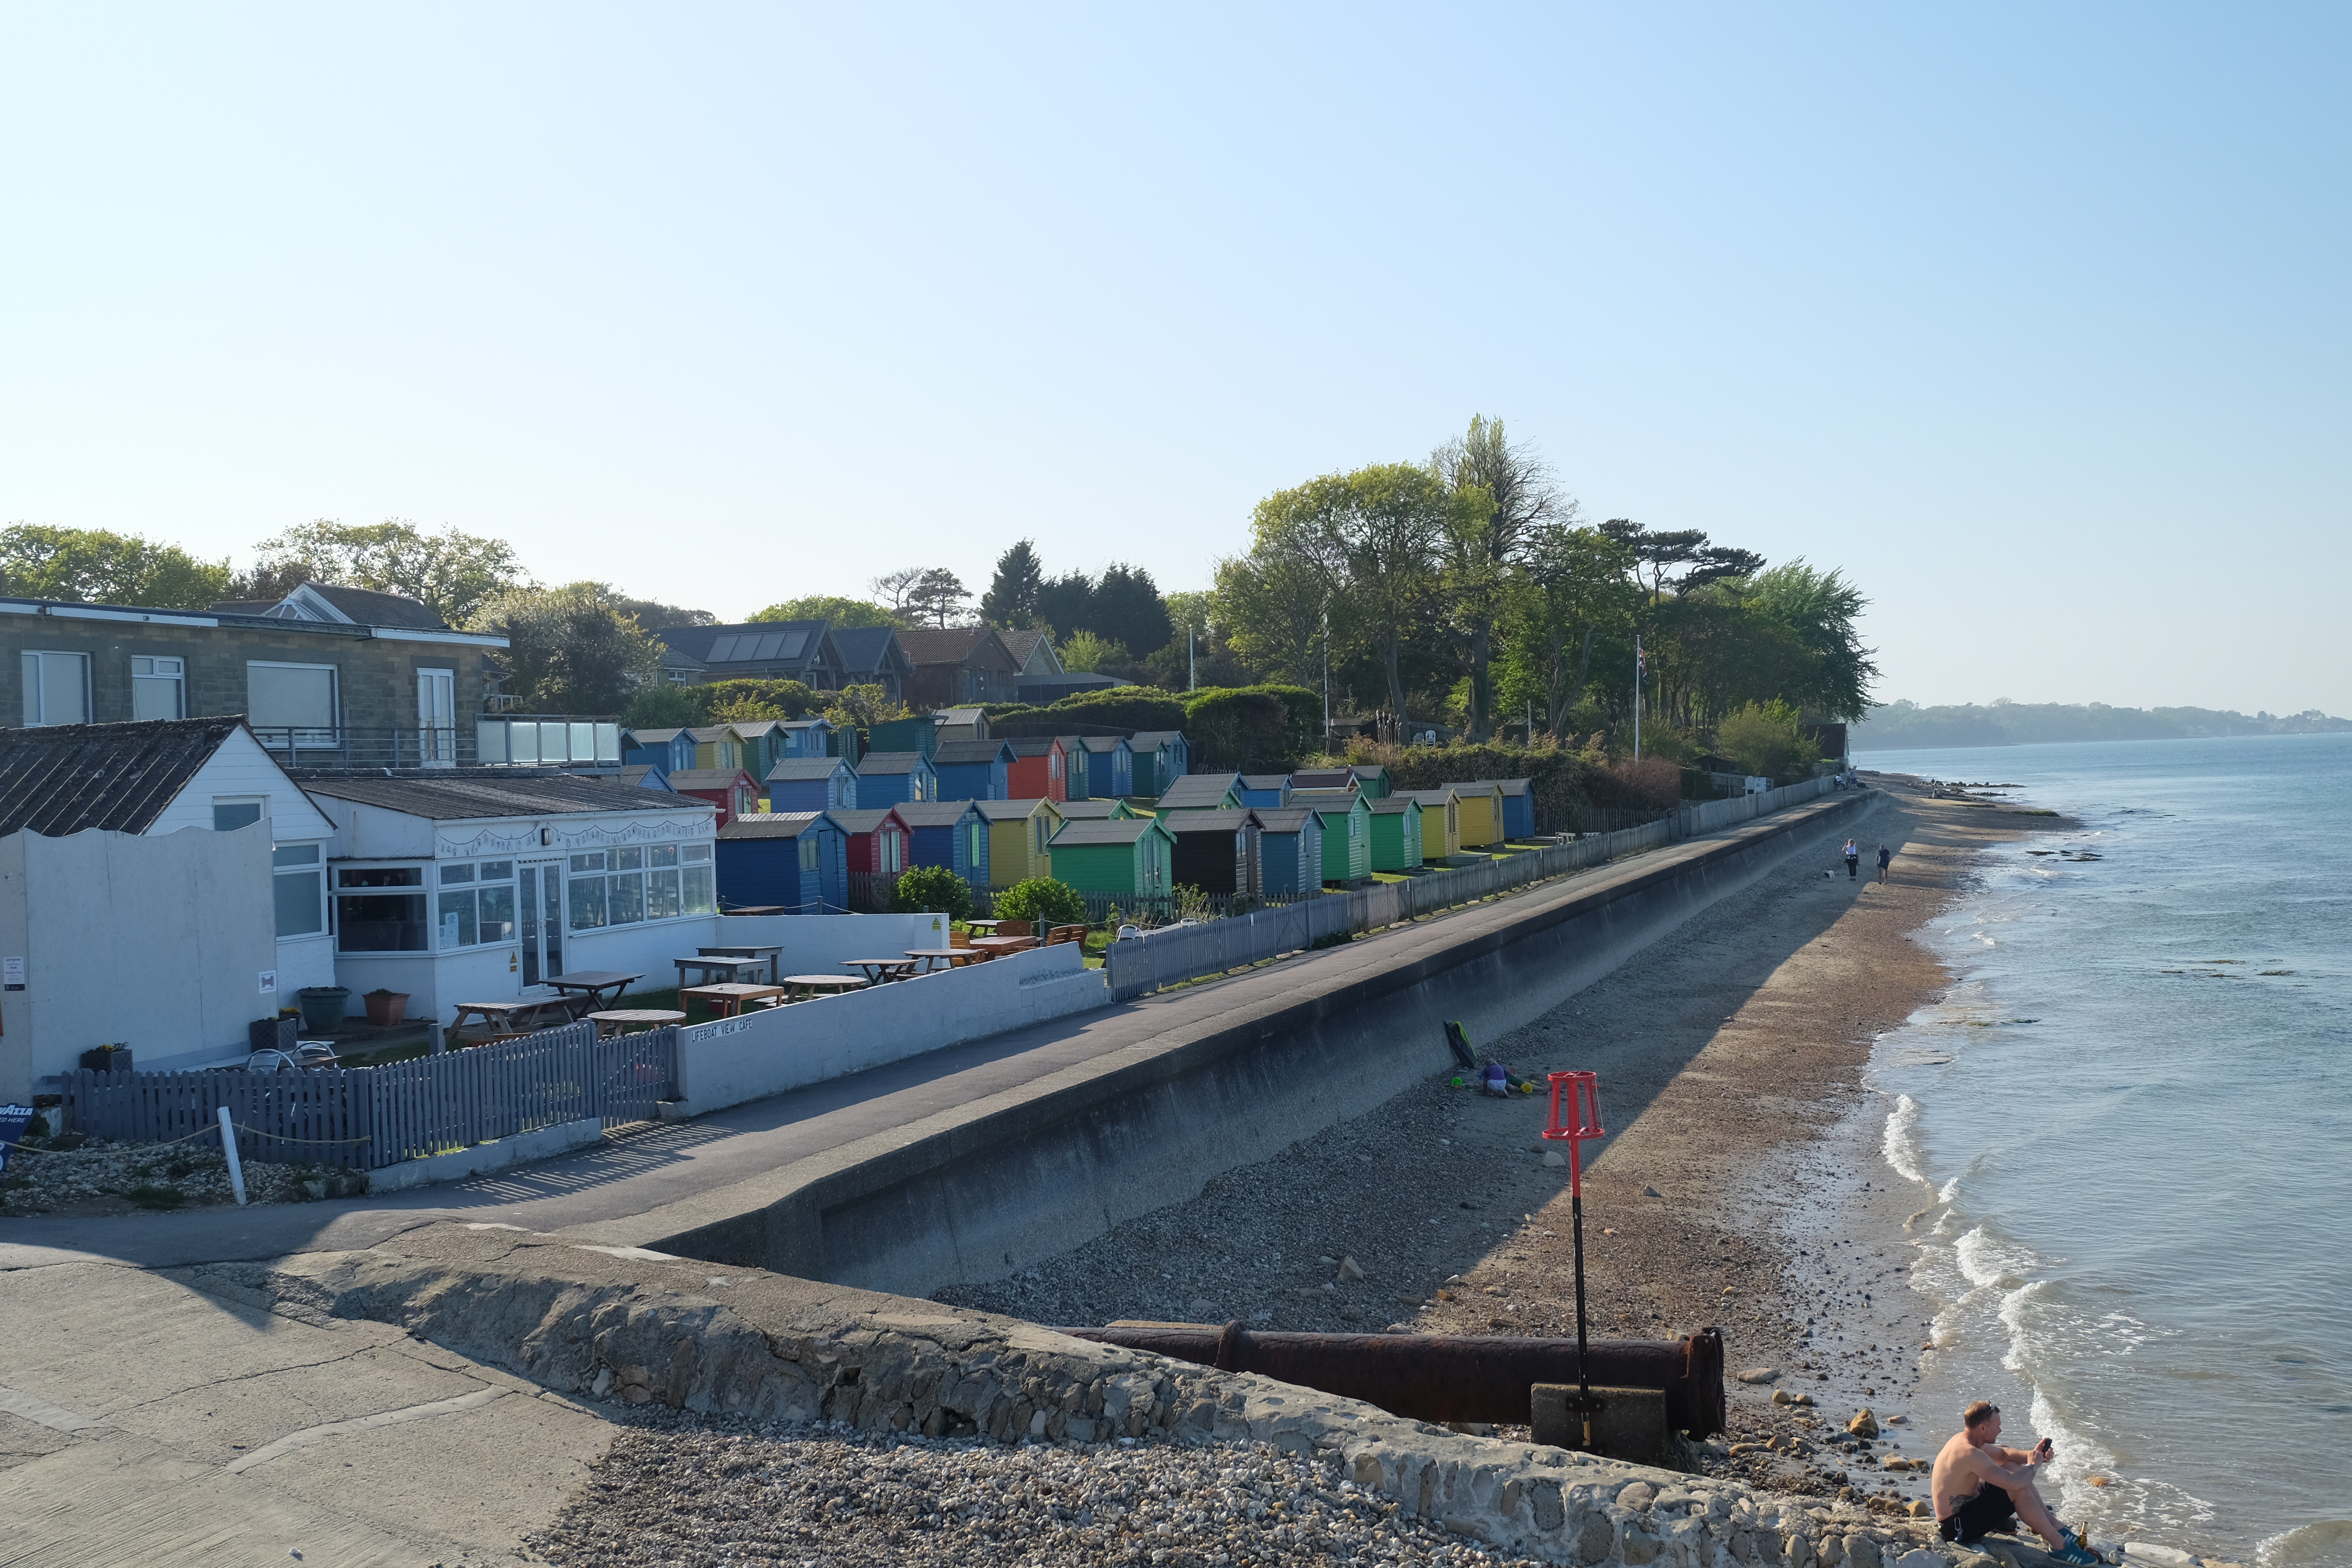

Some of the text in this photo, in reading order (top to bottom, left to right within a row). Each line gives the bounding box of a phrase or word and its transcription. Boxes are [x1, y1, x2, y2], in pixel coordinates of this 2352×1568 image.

[691, 1018, 752, 1042] LIFEBOAT VIEW CAFE
